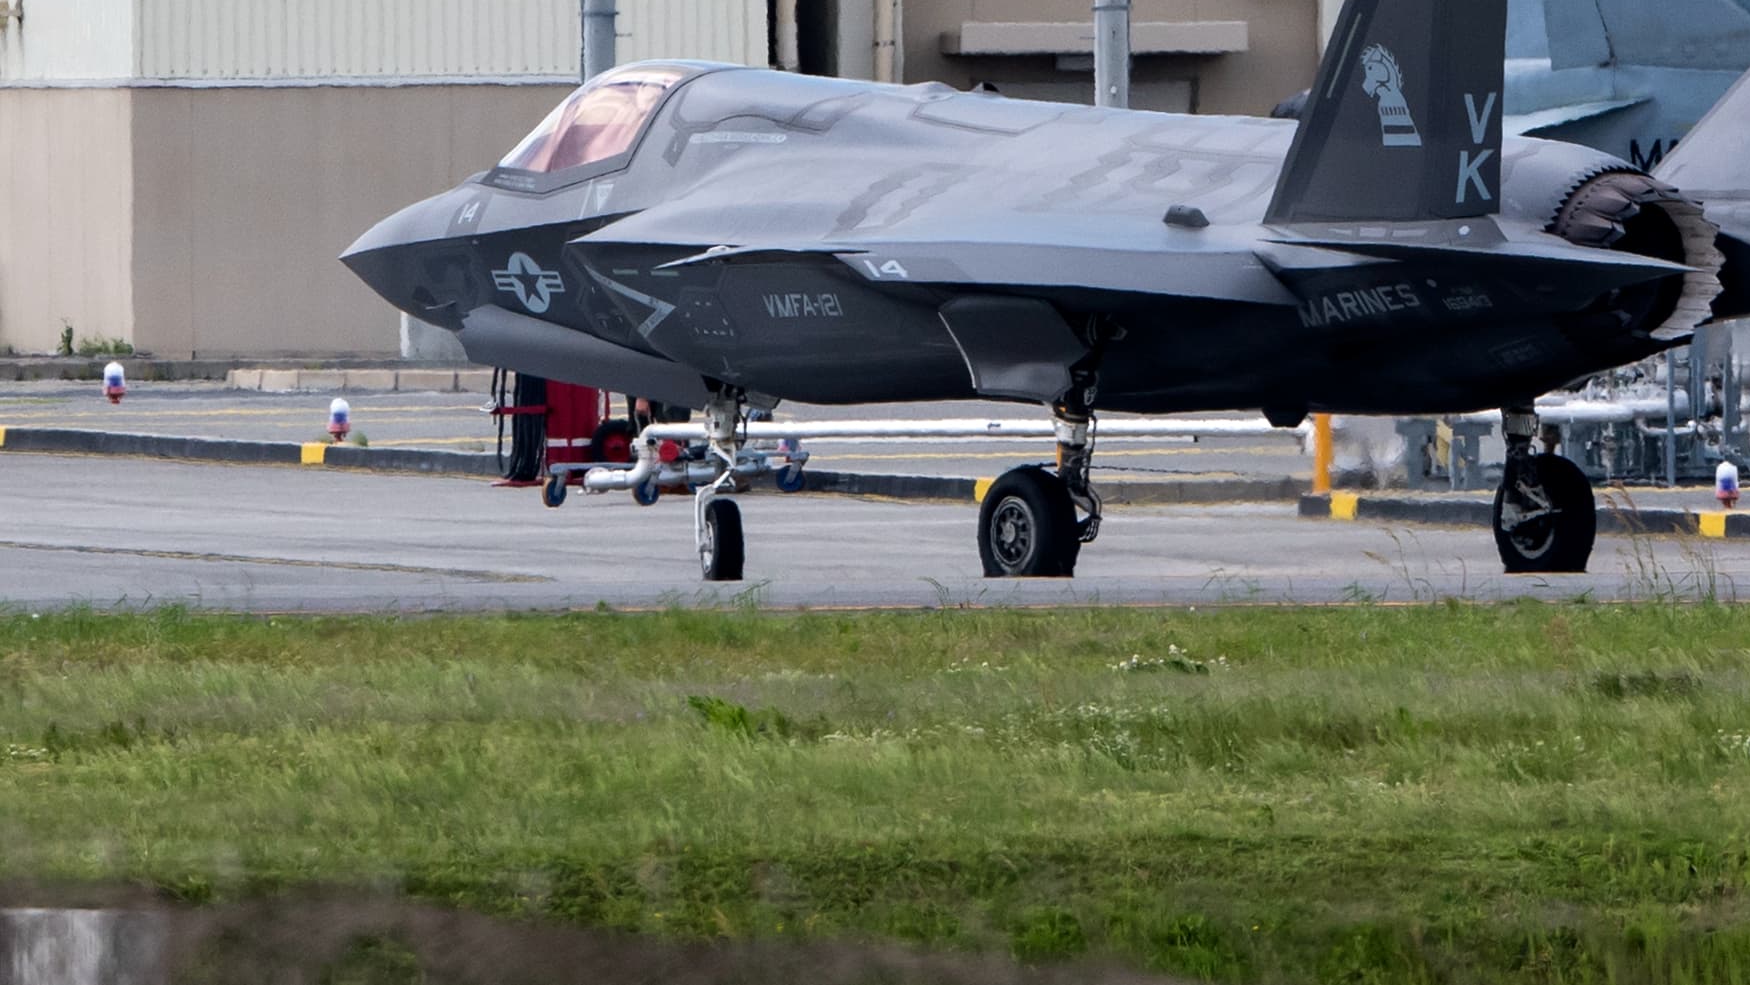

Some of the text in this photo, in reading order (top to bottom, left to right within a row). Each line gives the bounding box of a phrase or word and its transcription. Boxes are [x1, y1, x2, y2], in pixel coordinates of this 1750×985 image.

[1464, 91, 1497, 144] V
[1455, 148, 1494, 203] K
[458, 202, 480, 224] 14
[863, 259, 908, 278] 14
[761, 293, 844, 317] VMFA-121
[1297, 284, 1421, 328] MARINES
